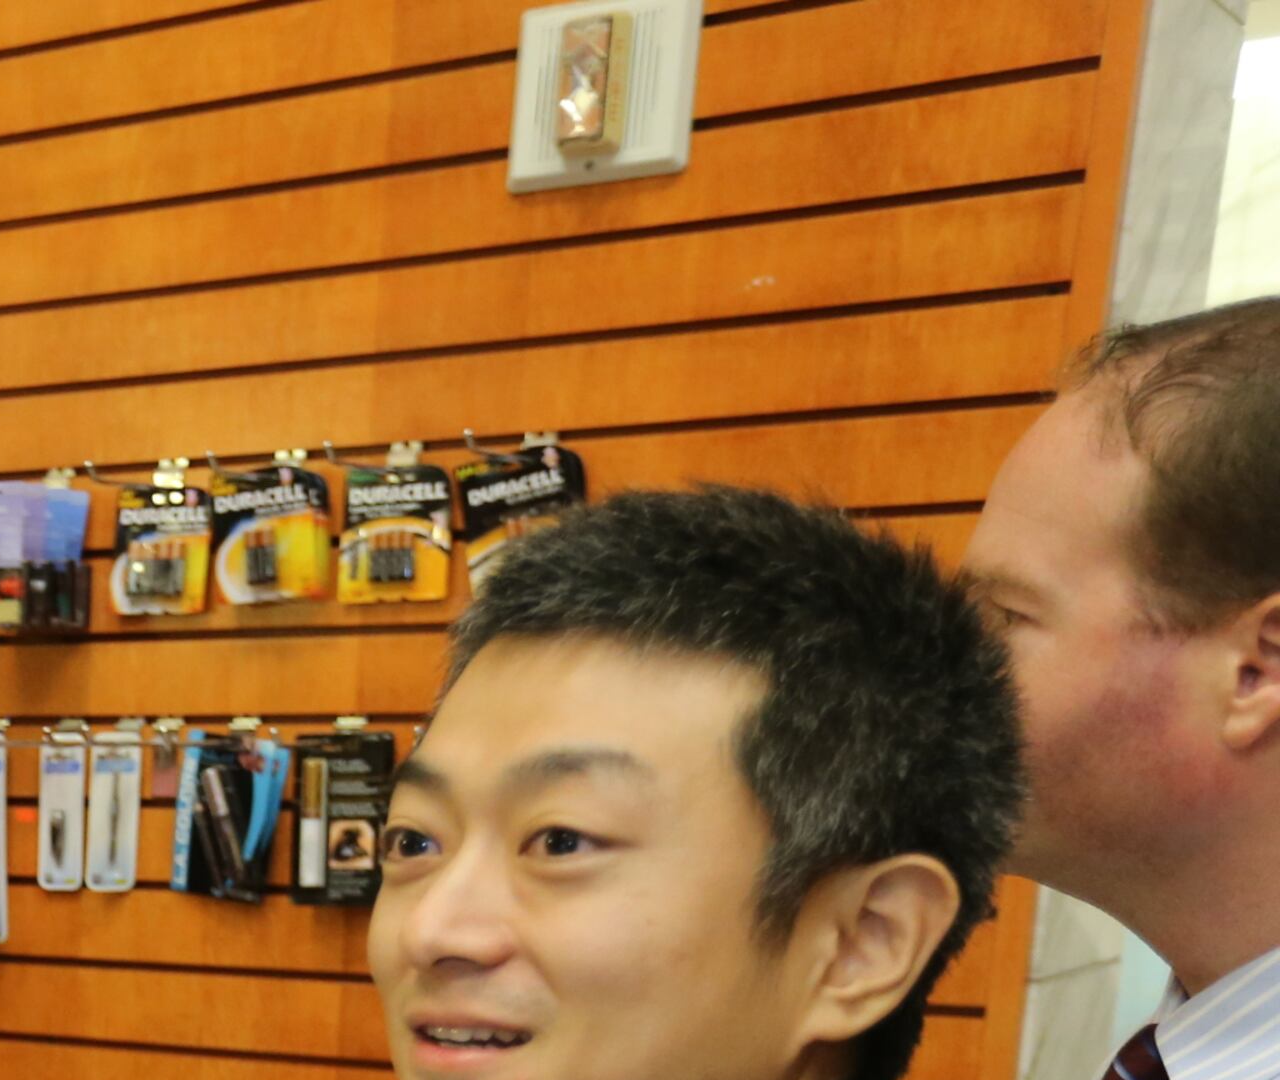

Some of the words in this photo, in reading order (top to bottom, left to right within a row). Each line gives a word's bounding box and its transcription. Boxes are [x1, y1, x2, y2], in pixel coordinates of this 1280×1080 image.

[214, 484, 307, 514] DURACELL
[348, 482, 448, 504] DURACELL
[467, 470, 565, 505] DURACELL
[119, 506, 208, 526] DURACELL
